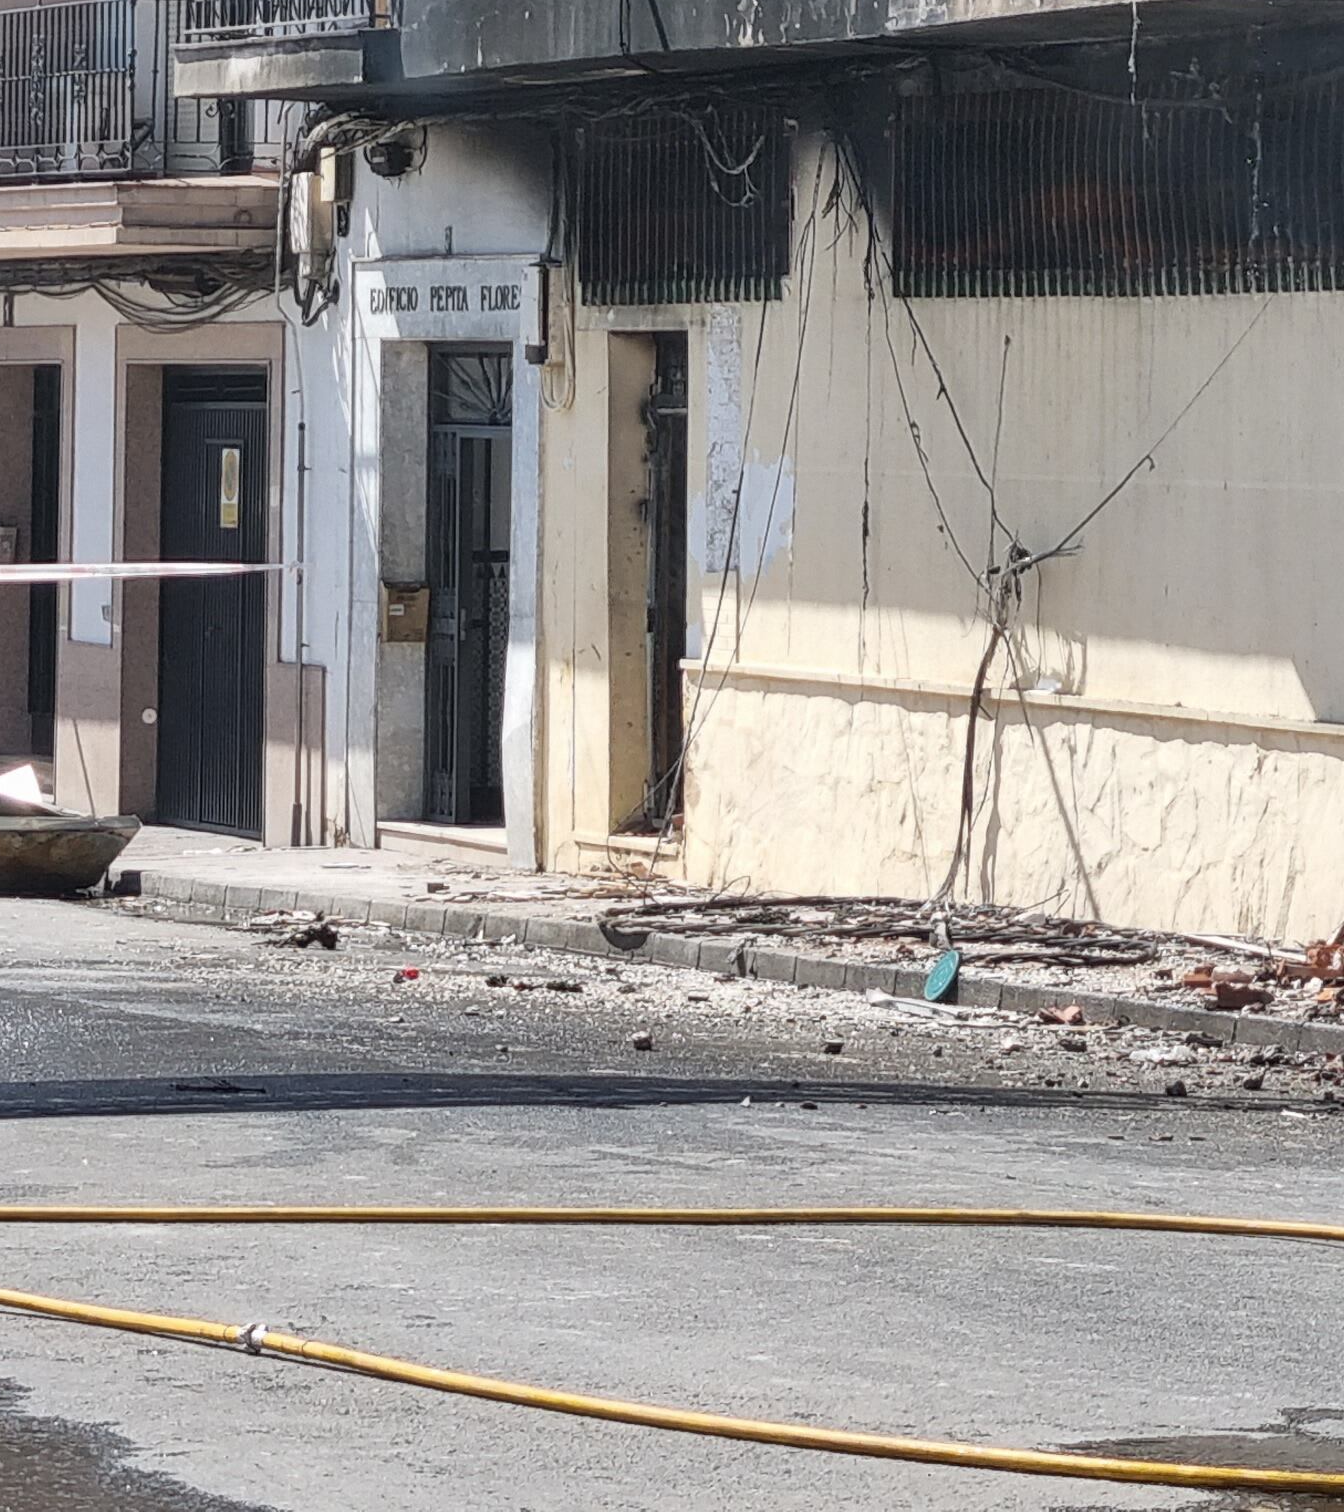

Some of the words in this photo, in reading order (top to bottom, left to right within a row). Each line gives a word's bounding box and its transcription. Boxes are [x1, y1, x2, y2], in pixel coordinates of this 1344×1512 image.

[370, 286, 418, 314] EDIFICIO
[430, 286, 469, 312] PEPITA
[480, 285, 521, 311] FLORE
